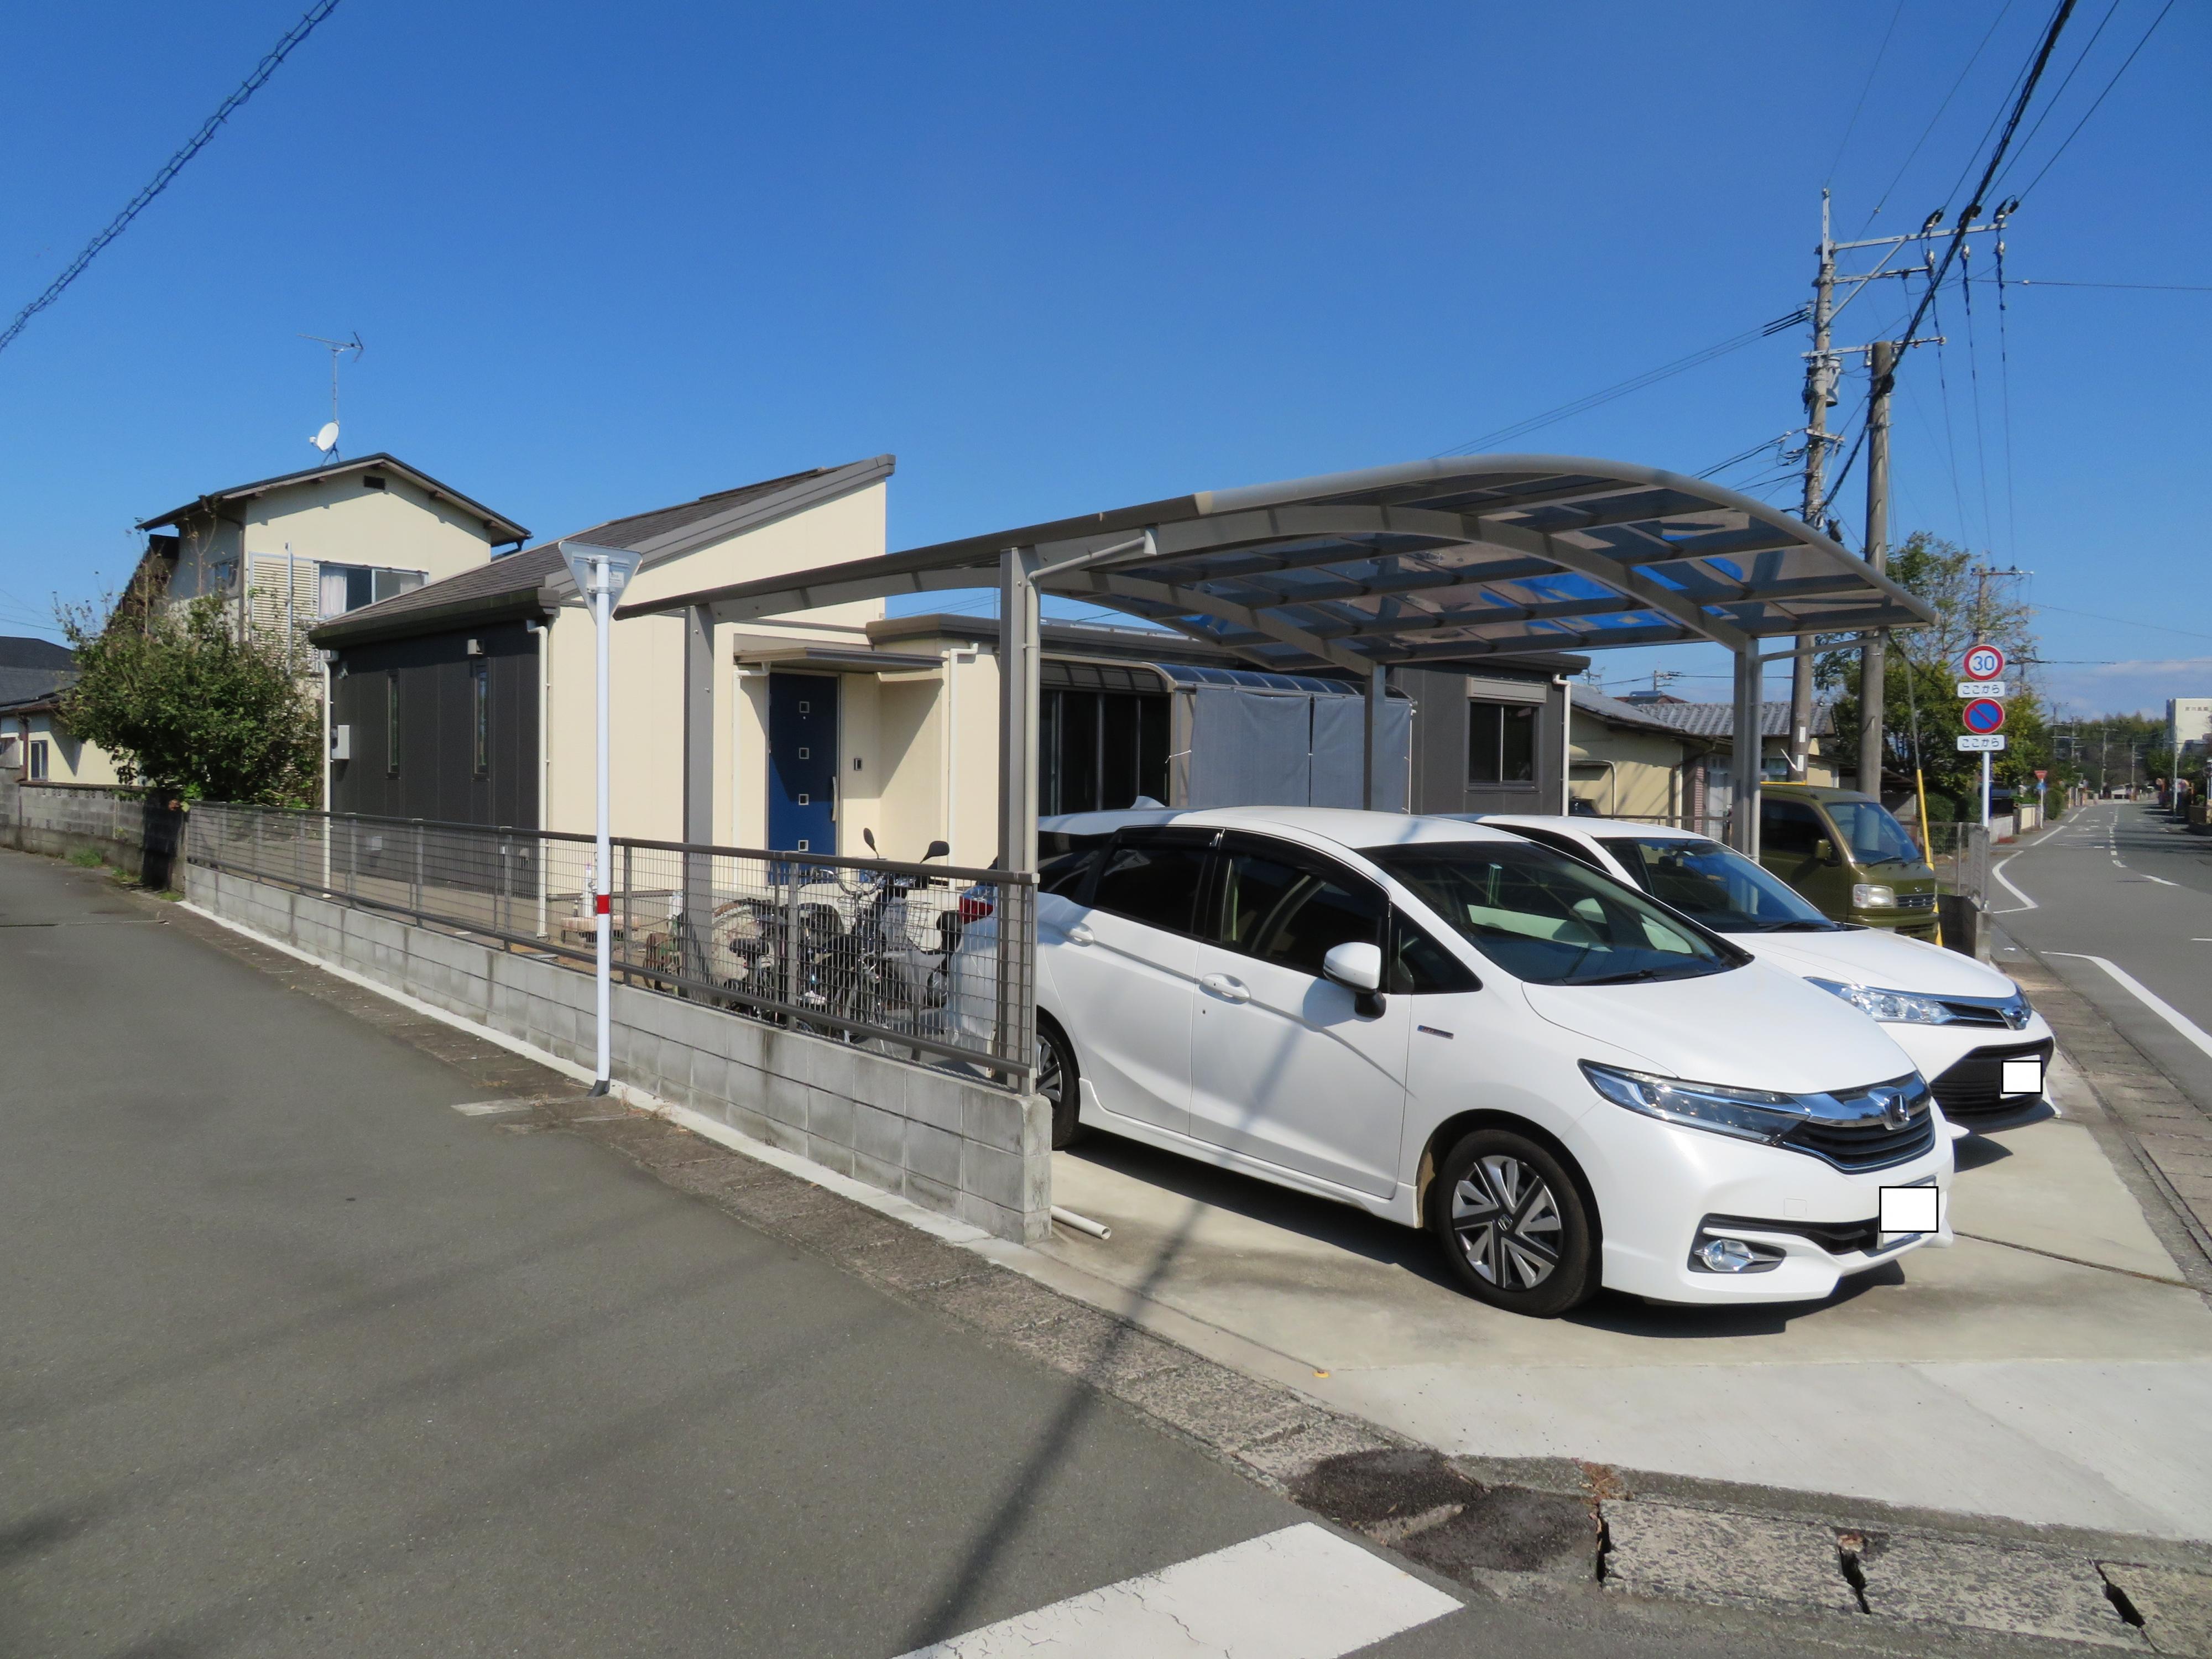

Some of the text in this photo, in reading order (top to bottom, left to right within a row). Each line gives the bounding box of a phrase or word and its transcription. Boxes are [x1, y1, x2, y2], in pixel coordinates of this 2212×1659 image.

[1973, 655, 1995, 671] 30
[1963, 684, 2000, 695] ここから
[1962, 738, 2000, 748] ここから
